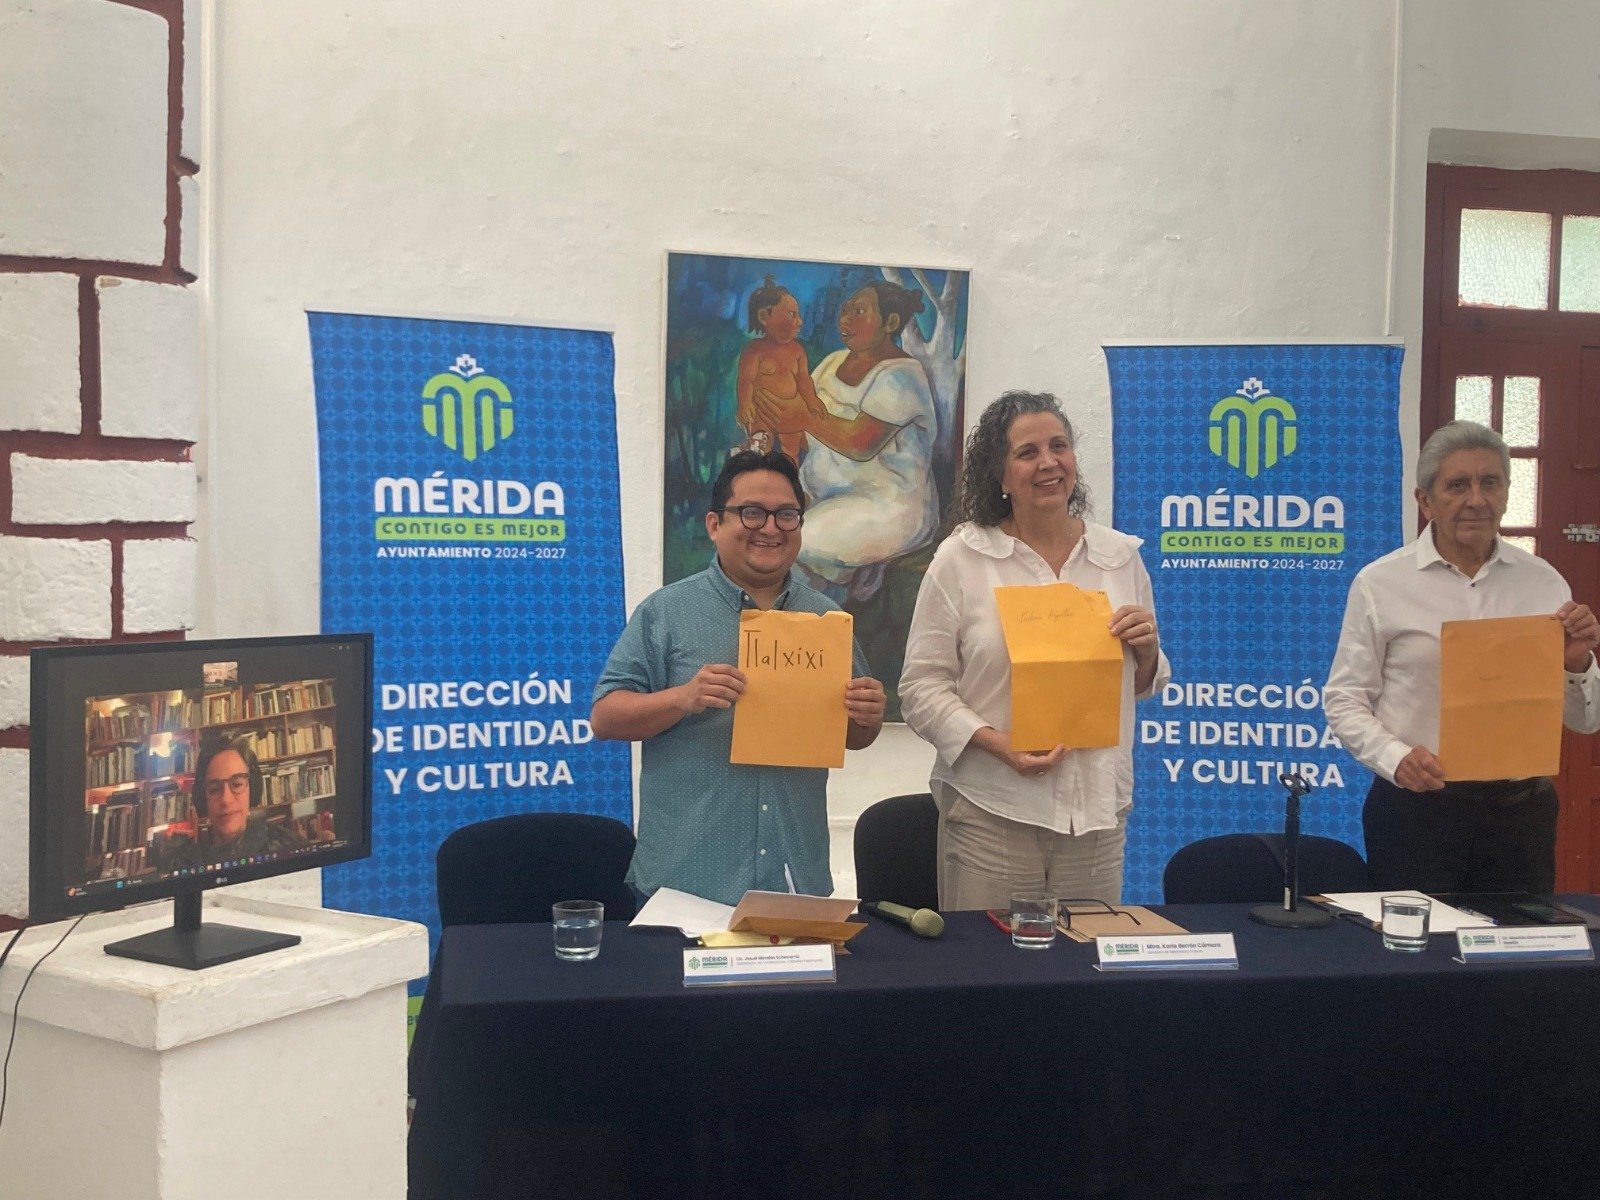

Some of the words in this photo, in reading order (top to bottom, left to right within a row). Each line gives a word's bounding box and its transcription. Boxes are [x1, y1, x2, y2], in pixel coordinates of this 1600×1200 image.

[374, 471, 565, 516] MÉRIDA
[1161, 487, 1345, 529] MÉRIDA
[382, 522, 467, 535] CONTIGO
[474, 523, 495, 535] ES
[502, 523, 561, 538] MEJOR
[1167, 536, 1246, 548] CONTIGO
[1253, 536, 1273, 547] ES
[1280, 536, 1339, 551] MEJOR
[376, 547, 492, 559] AYUNTAMIENTO
[495, 547, 566, 559] 2024-2027
[1161, 558, 1270, 569] AYUNTAMIENTO
[1272, 558, 1344, 571] 2024-2027
[744, 629, 824, 670] Tlalxixi
[381, 671, 572, 711] DIRECCIÓN
[1162, 677, 1326, 710] DIRECCIÓ
[413, 719, 594, 751] IDENTIDAD
[1141, 720, 1181, 745] DE
[1189, 721, 1343, 749] IDENTIDA
[384, 768, 408, 795] Y
[416, 760, 575, 793] CULTURA
[1163, 758, 1185, 783] Y
[1192, 759, 1345, 788] CULTURA
